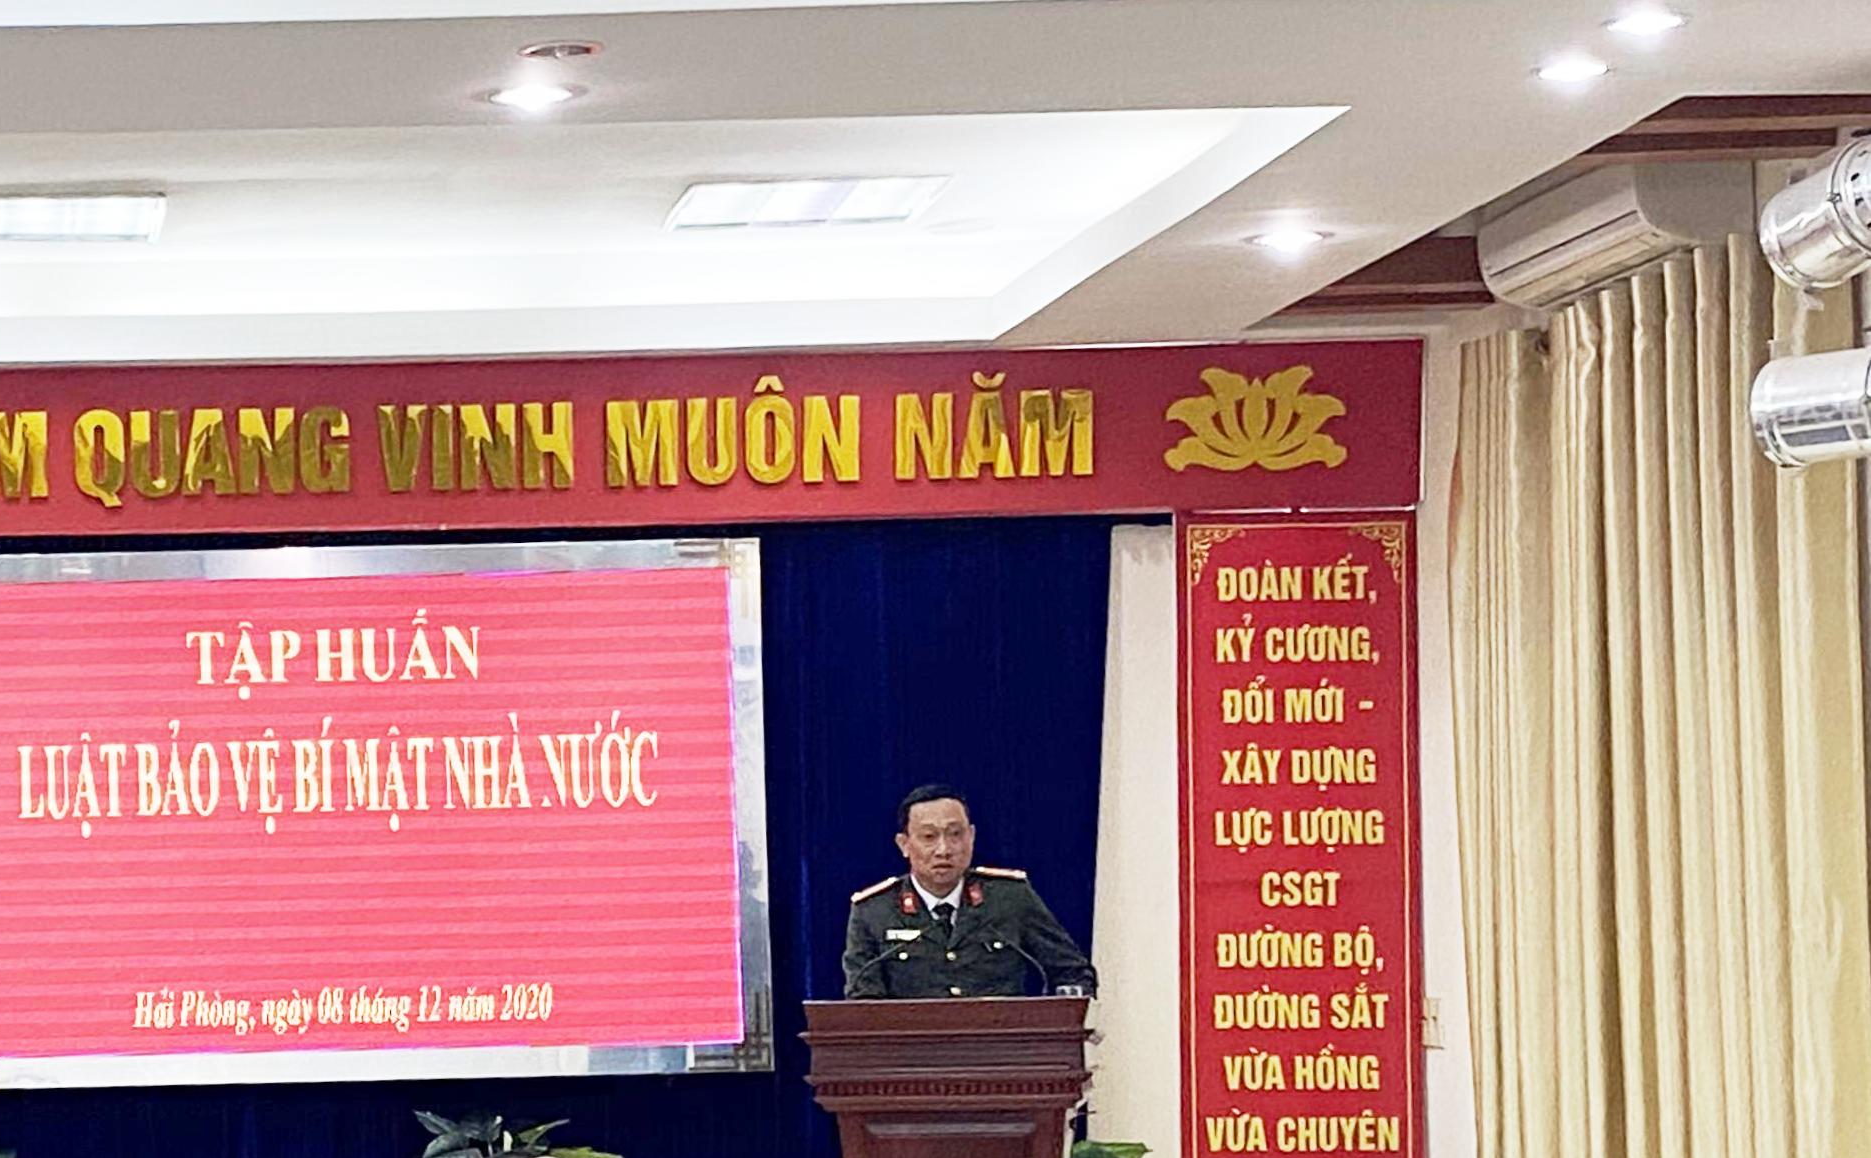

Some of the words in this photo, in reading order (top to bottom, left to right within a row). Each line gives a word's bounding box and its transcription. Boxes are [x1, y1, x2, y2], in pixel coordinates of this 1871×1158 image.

[73, 406, 350, 508] QUANG
[378, 402, 574, 492] VINH
[606, 375, 860, 487] MUÔN
[894, 370, 1094, 481] NĂM
[1218, 560, 1302, 601] ĐOÀN
[1313, 553, 1376, 603] KẾT,
[186, 621, 301, 700] TẬP
[315, 608, 479, 682] HUẤN
[1216, 614, 1255, 662] KỶ
[1265, 623, 1379, 664] CƯƠNG,
[1222, 676, 1274, 723] ĐỔI
[1285, 678, 1343, 723] MỚI
[17, 732, 126, 837] LUẬT
[135, 720, 219, 817] BẢO
[227, 727, 283, 833] VỆ
[292, 716, 336, 813] BÍ
[344, 726, 433, 831] MẬT
[442, 712, 531, 810] NHÀ
[538, 709, 657, 808] NƯỚC
[1222, 743, 1282, 784] XÂY
[1292, 746, 1376, 790] DỰNG
[1214, 808, 1272, 853] LỰC
[1283, 807, 1384, 853] LƯỢNG
[1261, 871, 1341, 907] CSGT
[1217, 924, 1323, 968] ĐƯỜNG
[1334, 925, 1383, 974] BỘ,
[133, 986, 176, 1029] Hải
[180, 989, 256, 1035] Phòng,
[261, 989, 313, 1034] ngày
[317, 987, 344, 1023] 08
[349, 985, 412, 1032] tháng
[416, 985, 441, 1022] 12
[447, 984, 495, 1021] năm
[500, 982, 553, 1021] 2020
[1214, 985, 1320, 1030] ĐƯỜNG
[1331, 982, 1389, 1029] SẮT
[1224, 1047, 1286, 1091] VỪA
[1295, 1044, 1379, 1090] HỒNG
[1206, 1108, 1267, 1152] VỪA
[1277, 1109, 1400, 1152] CHUYÊN
